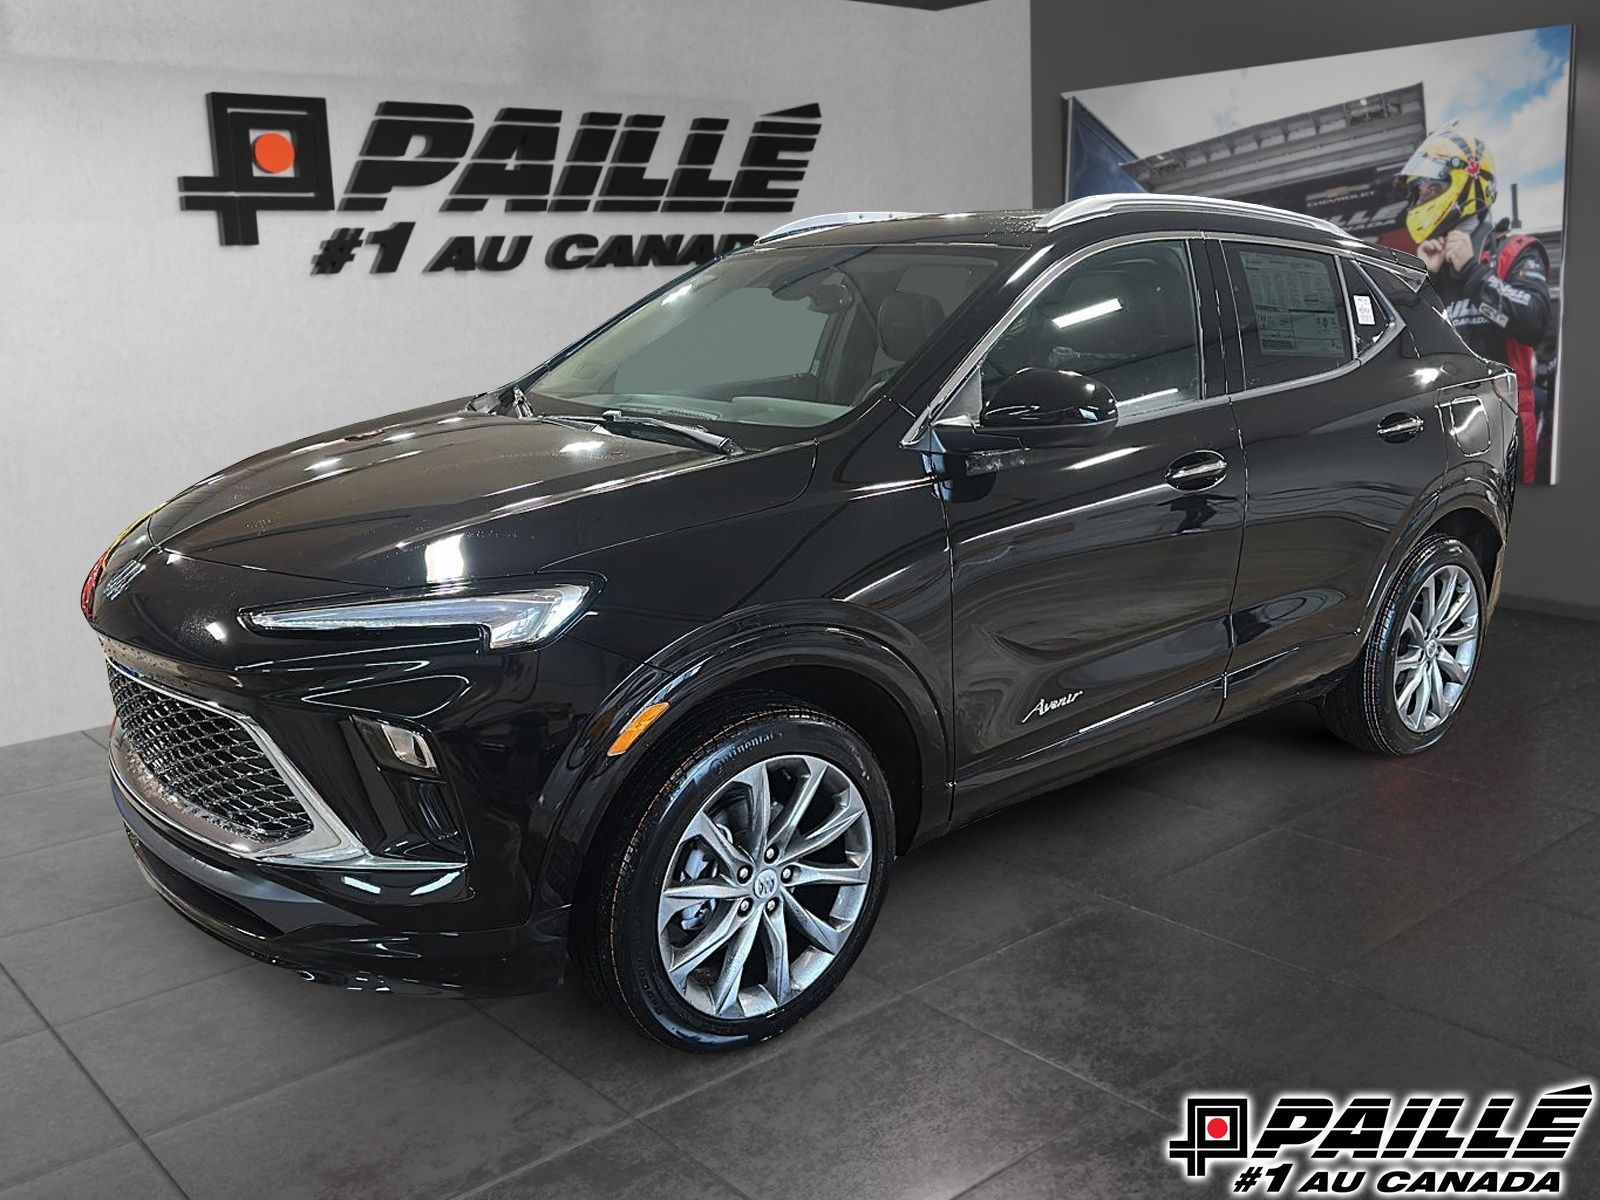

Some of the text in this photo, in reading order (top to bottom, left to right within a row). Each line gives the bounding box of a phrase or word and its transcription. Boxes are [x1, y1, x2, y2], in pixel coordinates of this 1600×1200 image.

[337, 101, 822, 212] PAILLÉ
[311, 221, 416, 275] #1
[422, 235, 533, 273] AU
[1021, 690, 1084, 723] Avenir
